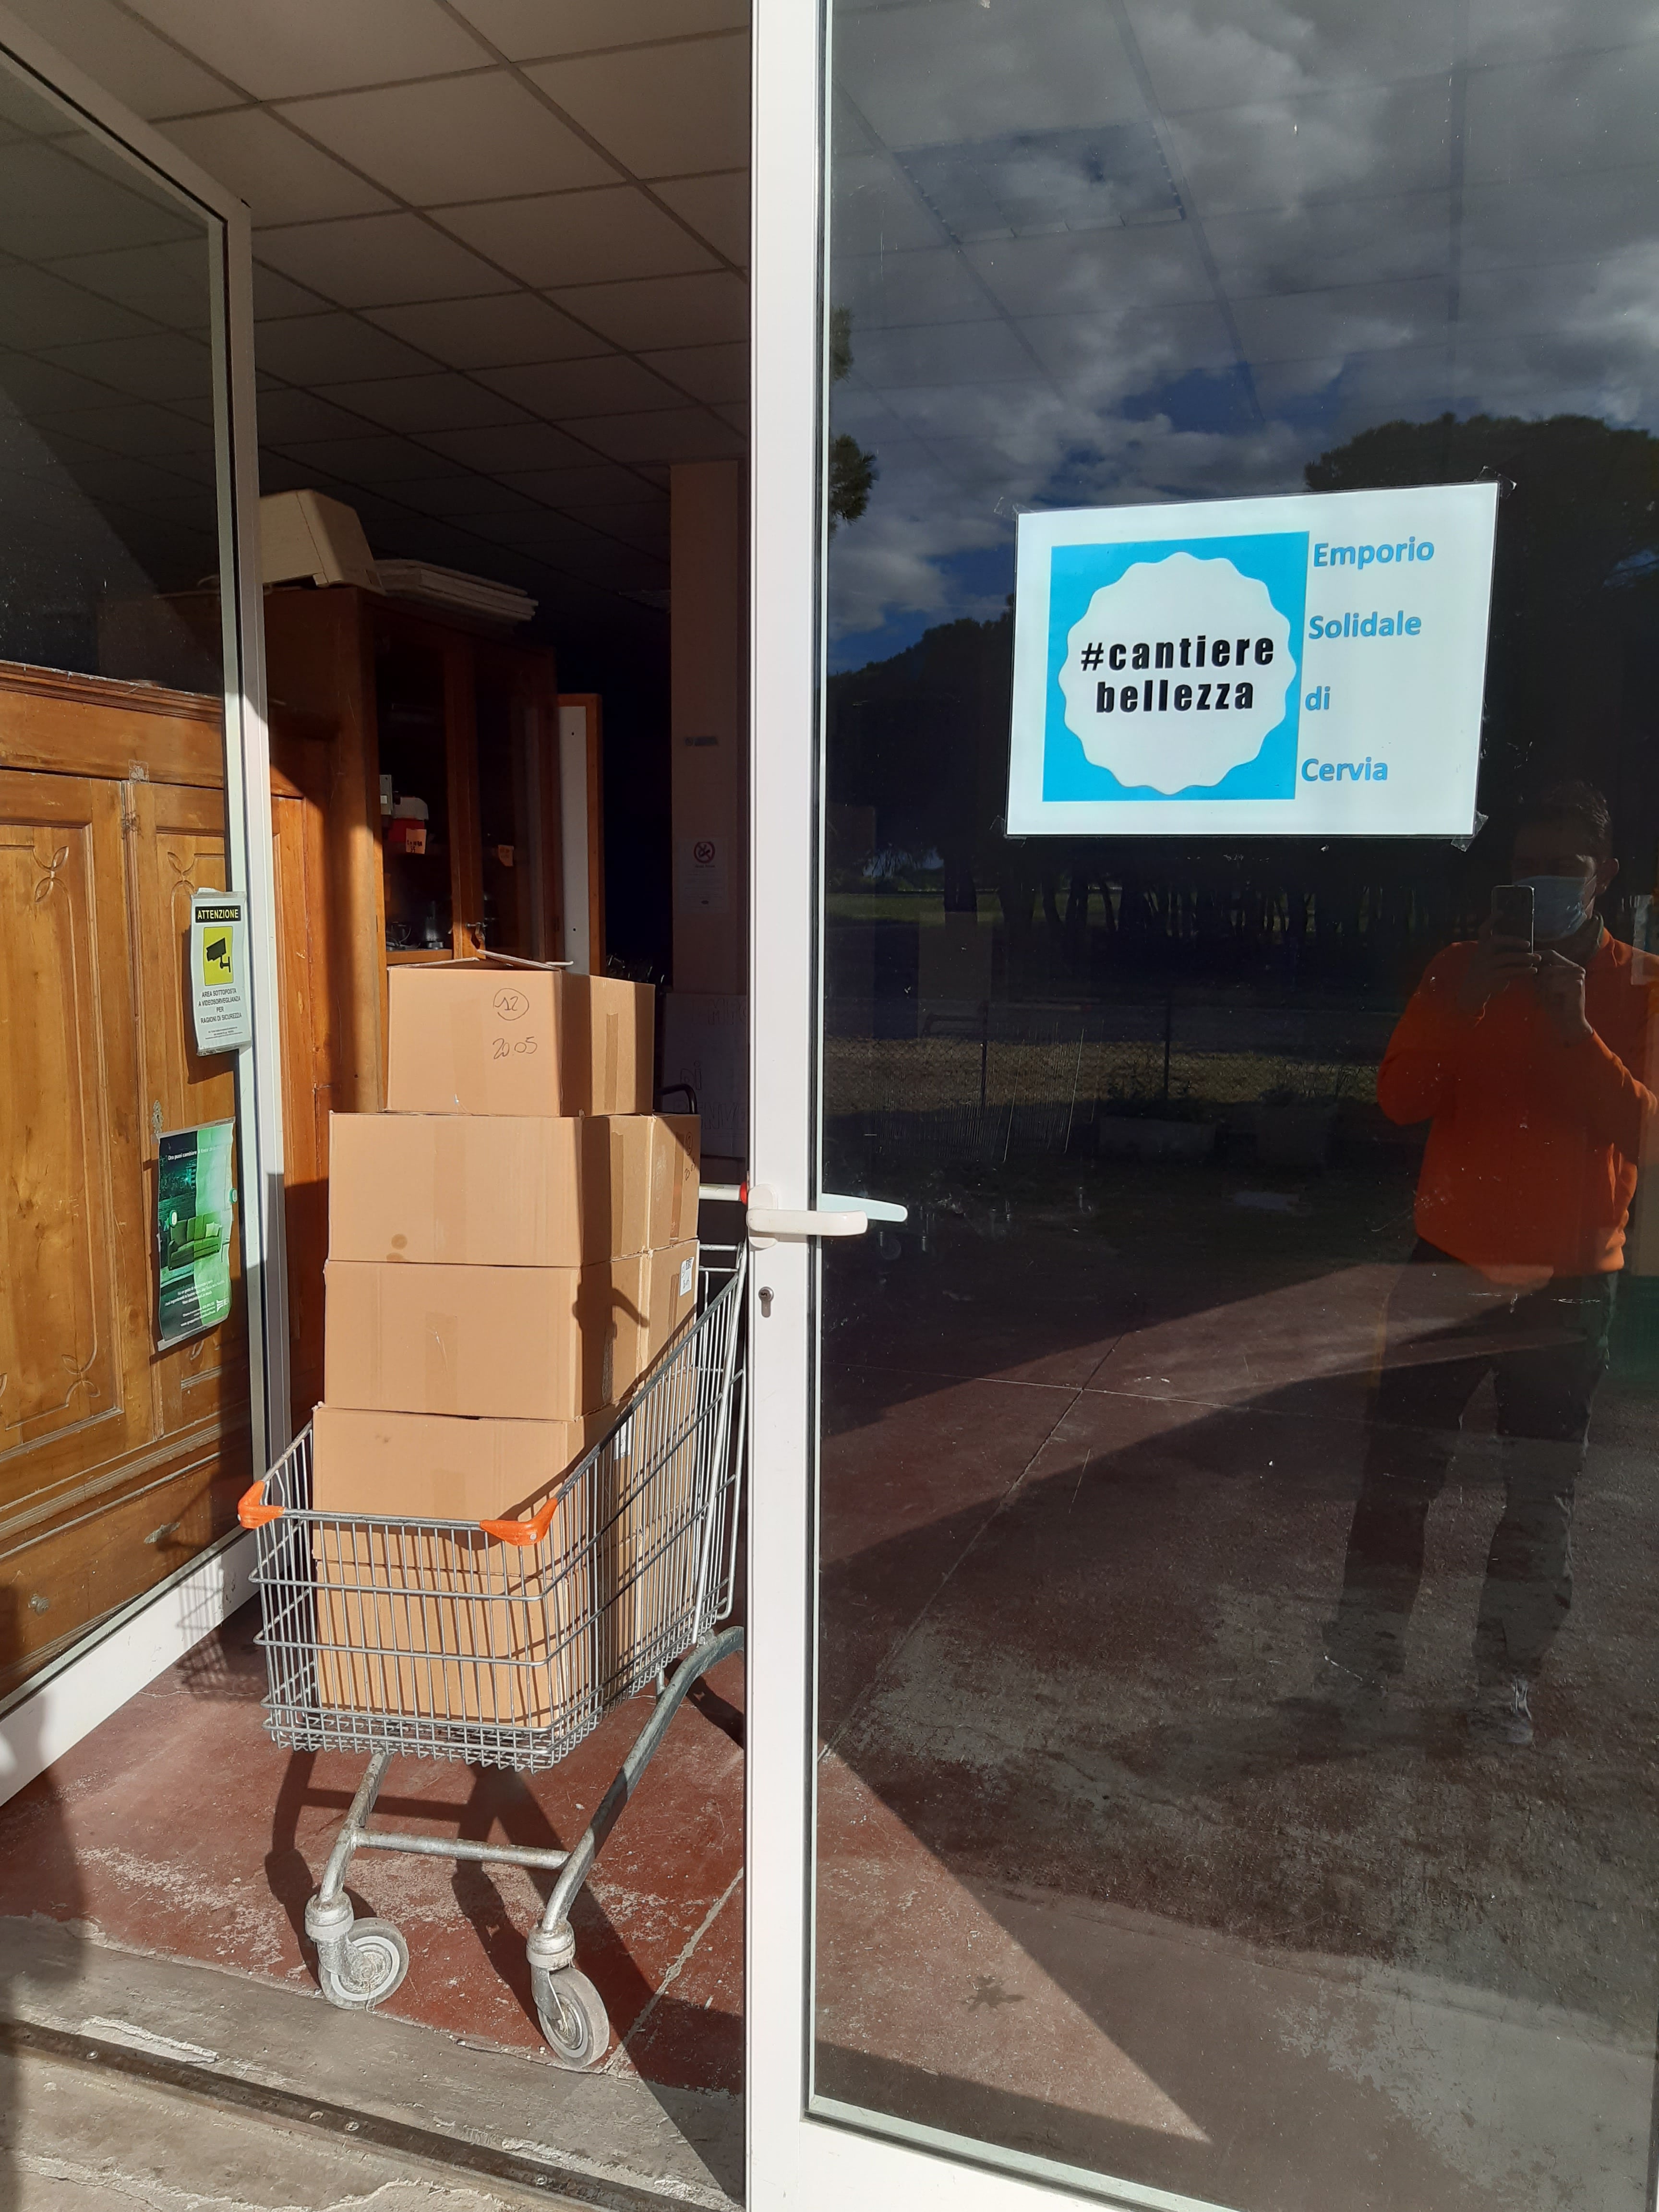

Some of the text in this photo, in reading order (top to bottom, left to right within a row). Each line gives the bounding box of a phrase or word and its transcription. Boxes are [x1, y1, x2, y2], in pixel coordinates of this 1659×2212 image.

[1313, 536, 1435, 570] Emporio
[1308, 610, 1422, 640] Solidale
[1081, 635, 1274, 671] #cantiere
[1096, 679, 1254, 713] bellezza
[1305, 685, 1331, 711] di
[1301, 756, 1389, 782] Cervia
[197, 909, 239, 920] ATTENZIONE
[202, 996, 240, 1006] VIDEOSORVEGLIANZA
[213, 988, 237, 996] SOTTOPOSTA
[201, 1015, 217, 1023] RAGIONI
[222, 1012, 242, 1021] SICUREZZA
